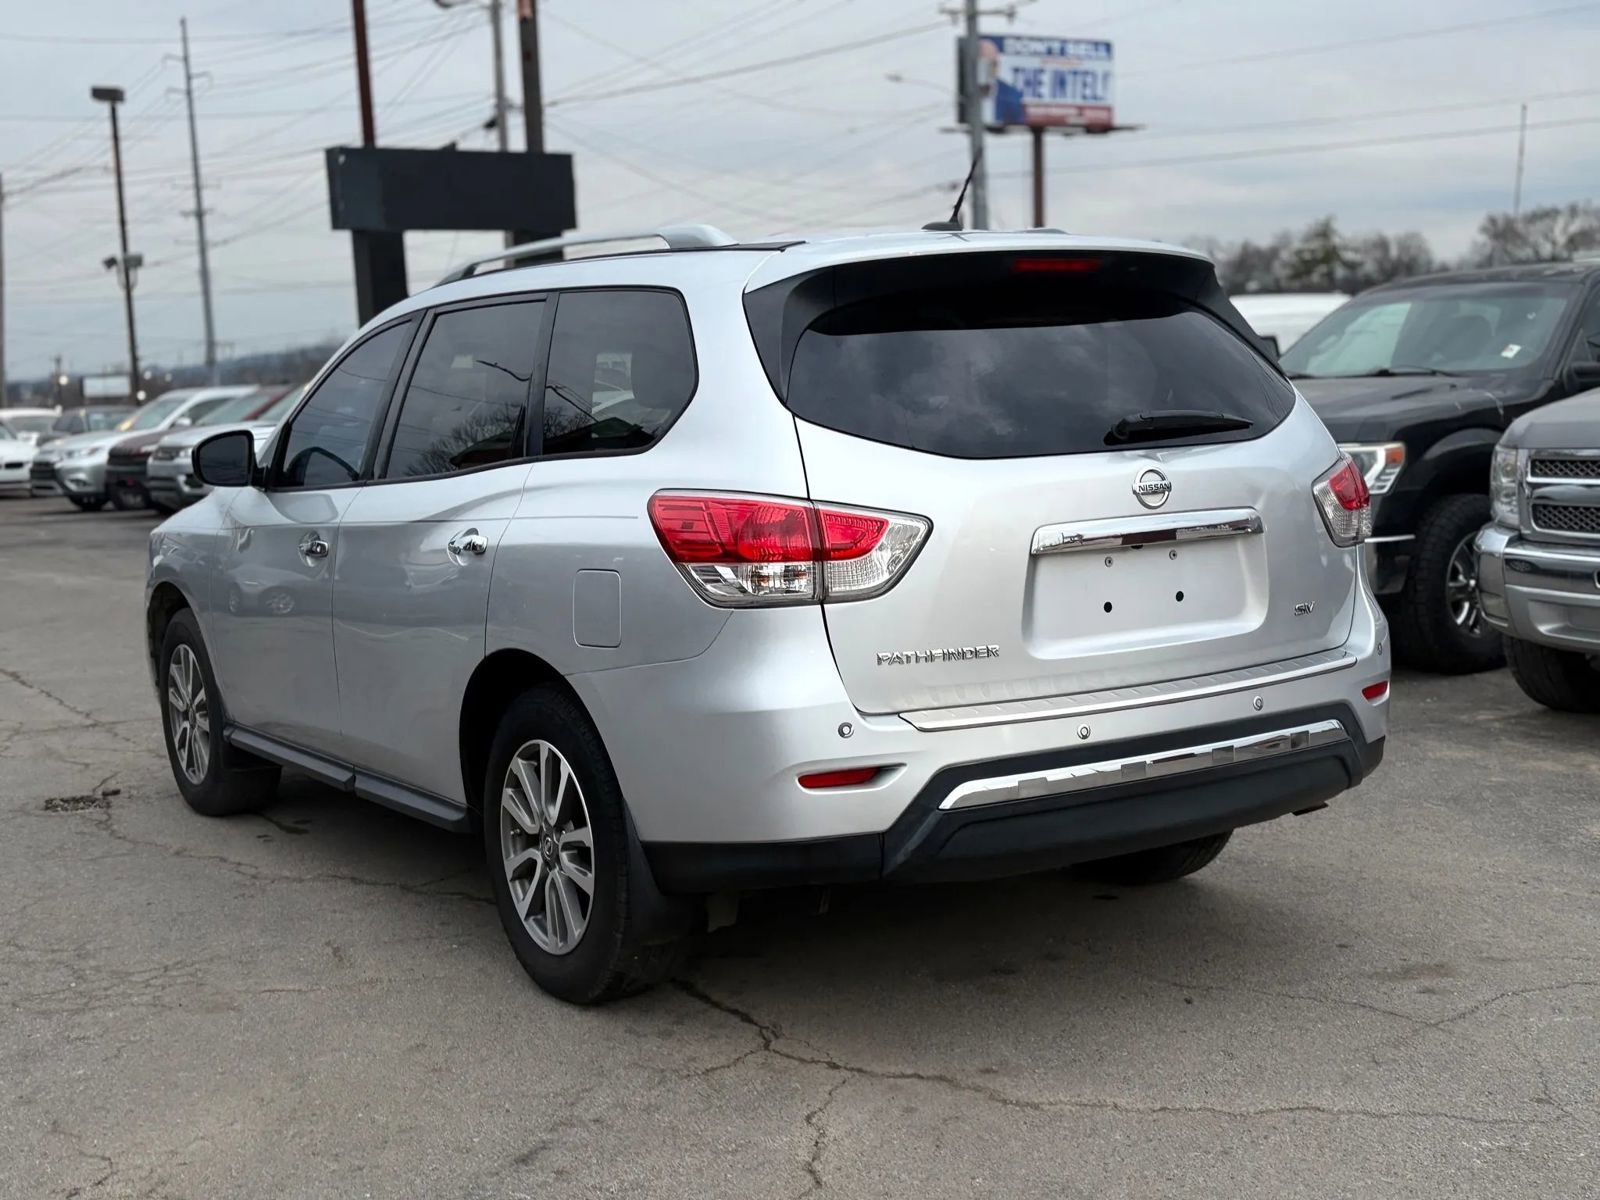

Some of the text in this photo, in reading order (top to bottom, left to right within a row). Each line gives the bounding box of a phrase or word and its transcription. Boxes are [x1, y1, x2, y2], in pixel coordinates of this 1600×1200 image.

[1012, 67, 1044, 99] THE
[1138, 482, 1170, 492] NISSAN
[1294, 600, 1316, 616] SV
[876, 644, 1000, 666] PATHFINDER
